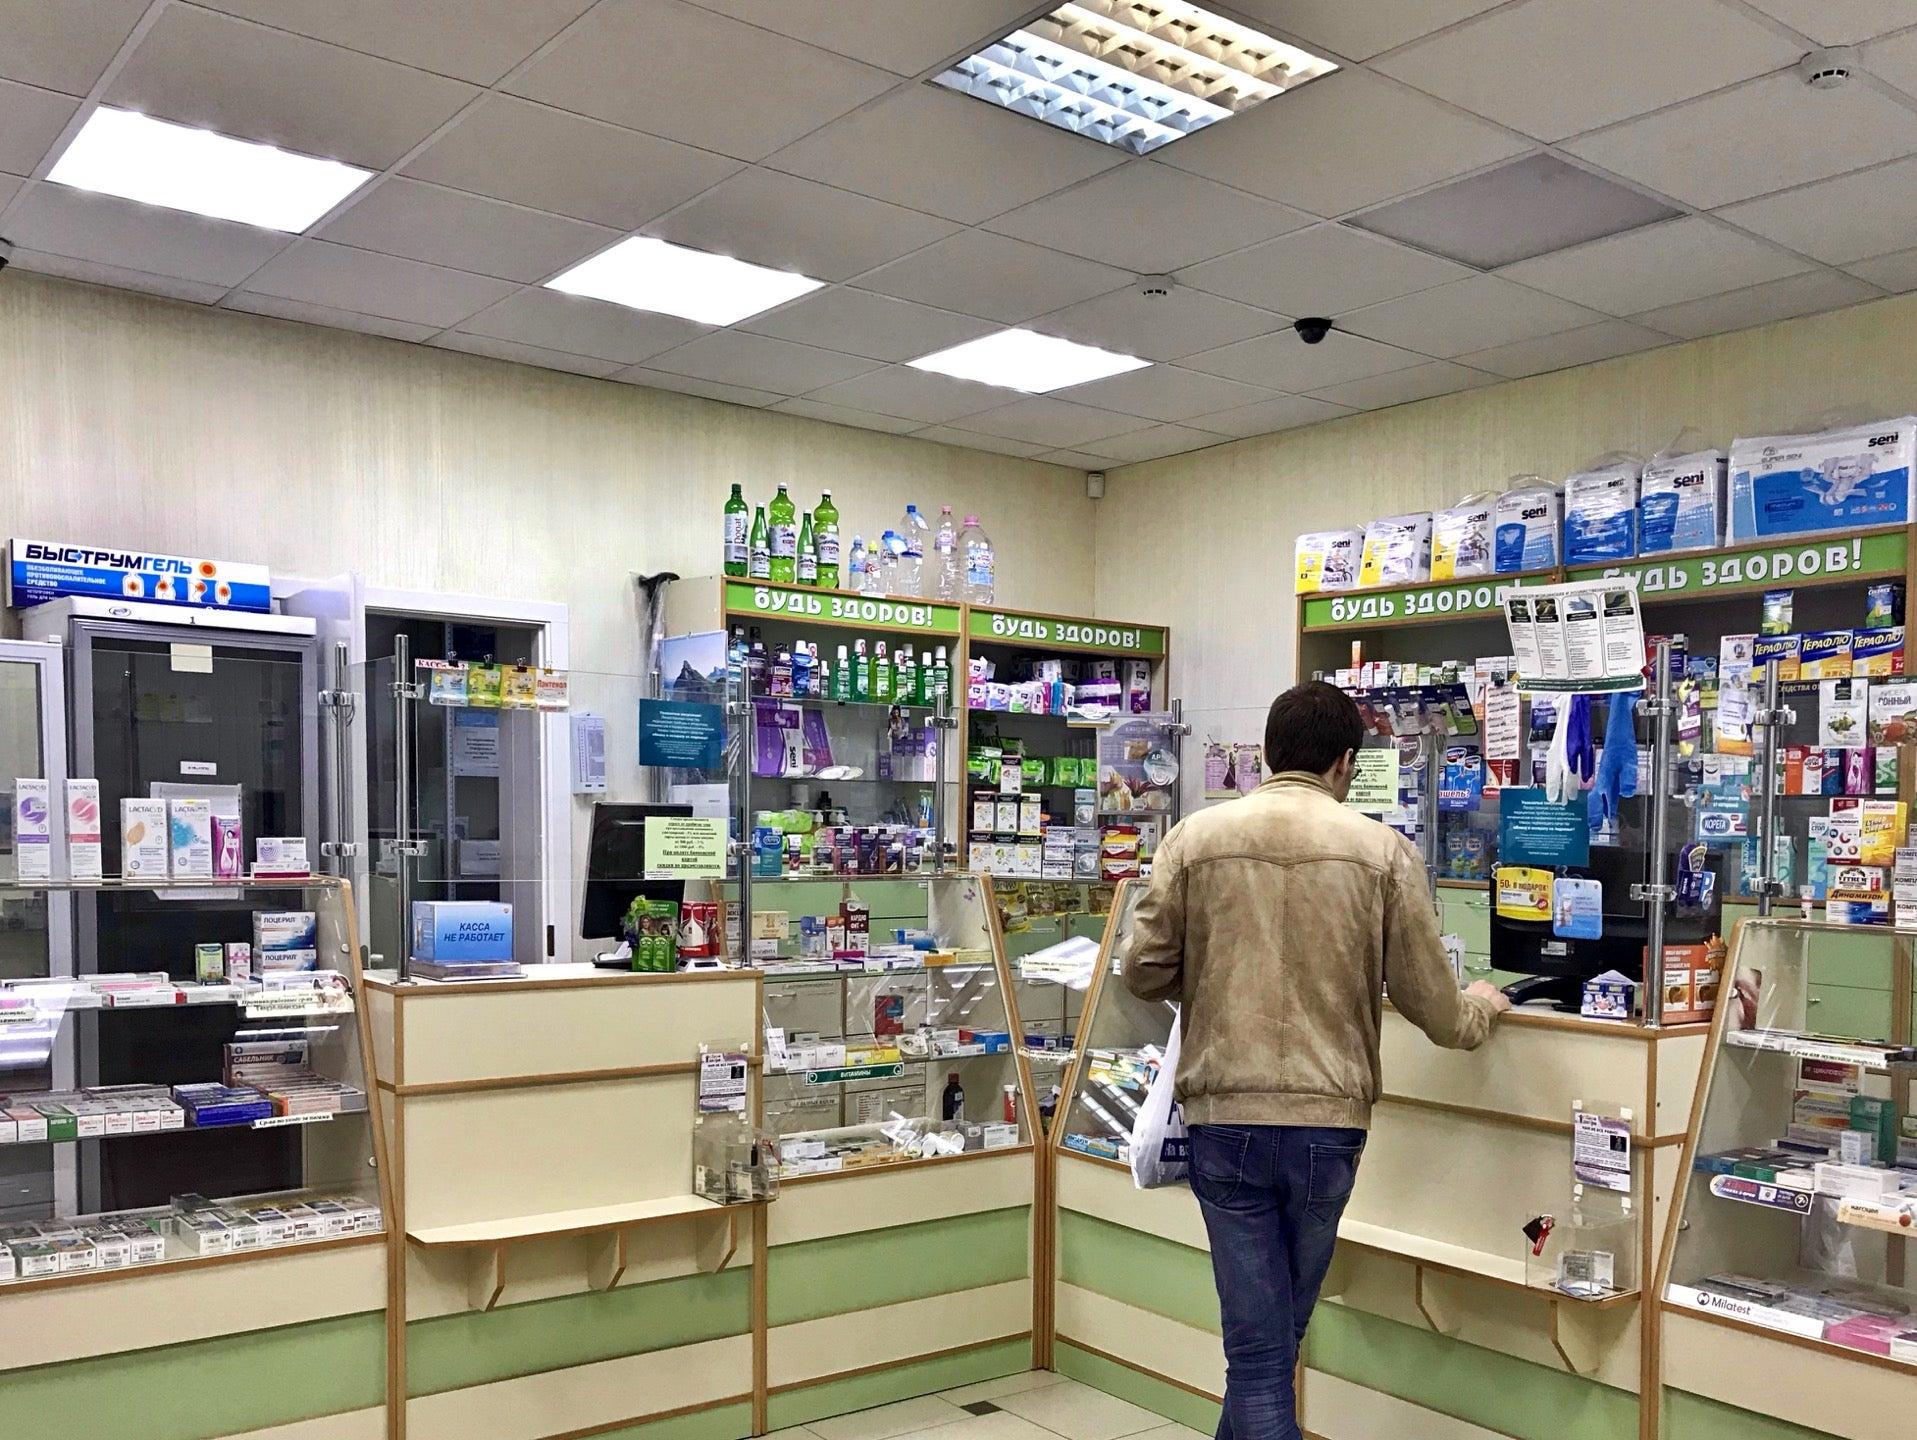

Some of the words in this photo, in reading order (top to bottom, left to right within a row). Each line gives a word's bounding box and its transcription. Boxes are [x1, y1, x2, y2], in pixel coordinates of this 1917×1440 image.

[1867, 431, 1899, 447] seni
[1673, 471, 1704, 489] seni
[1521, 504, 1547, 520] seni
[1331, 539, 1352, 549] seni
[25, 544, 193, 575] БЫСТРУМГЕЛЬ
[1701, 538, 1862, 585] здоров!
[26, 578, 59, 588] СРЕДСТВО
[754, 586, 822, 616] будь
[831, 595, 934, 628] здоров!
[1331, 596, 1395, 622] будь
[190, 616, 196, 625] 1
[991, 614, 1049, 640] будь
[1055, 622, 1142, 649] здоров!
[1754, 639, 1797, 657] ТЕРАФЛЮ
[1802, 635, 1850, 653] ТЕРАФЛЮ
[1854, 632, 1901, 649] ТЕРАФЛЮ
[418, 659, 447, 671] КАСС
[790, 746, 798, 768] seni
[1439, 788, 1471, 798] ашель?
[1704, 819, 1726, 830] КОРЕГА
[459, 922, 490, 931] КАССА
[444, 933, 457, 942] НЕ
[458, 932, 506, 942] РАБОТАЕТ
[264, 953, 297, 962] ЛОЦЕРИЛ
[233, 1055, 274, 1064] САБЕЛЬНИК
[840, 1068, 872, 1078] ВИТАМИНЫ
[1711, 1297, 1750, 1316] Milatest
